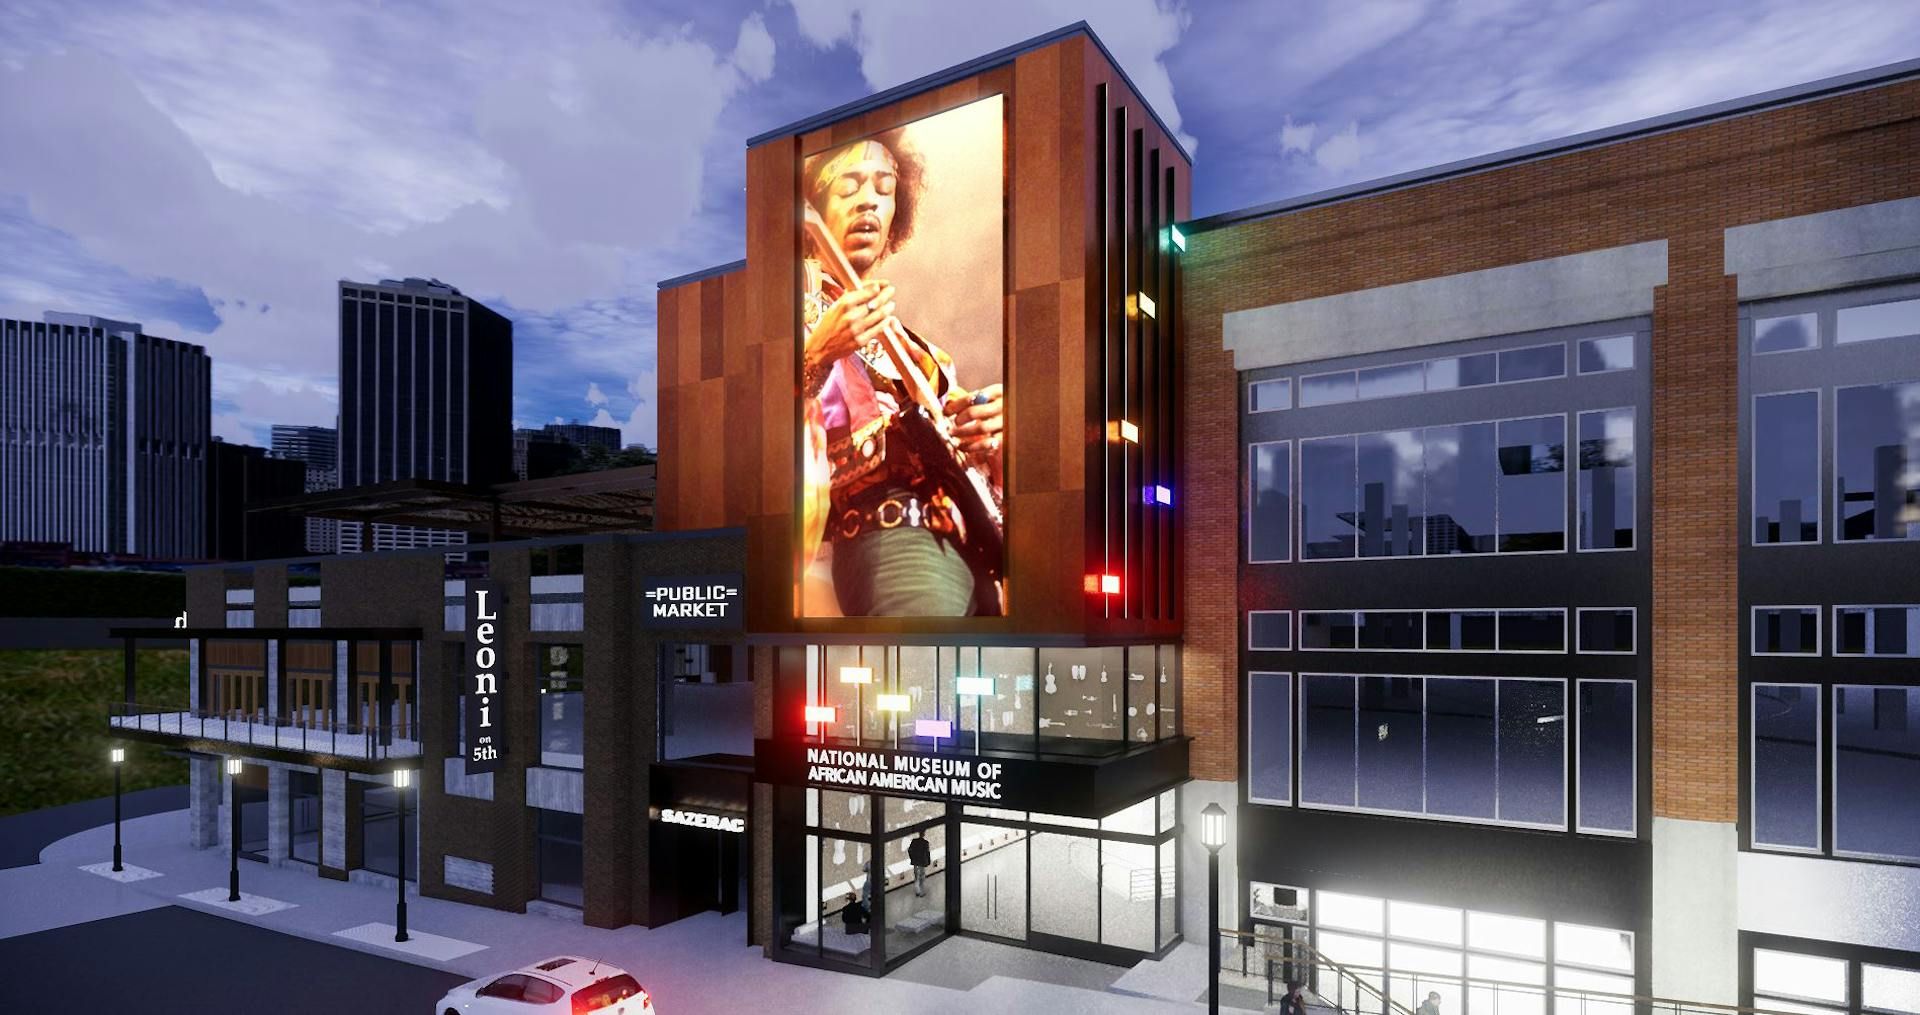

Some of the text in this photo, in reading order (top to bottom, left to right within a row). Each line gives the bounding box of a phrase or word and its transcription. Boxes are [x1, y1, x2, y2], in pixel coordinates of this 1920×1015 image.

[653, 602, 729, 617] MARKET
[475, 590, 497, 728] Leoni
[479, 735, 492, 744] on
[472, 745, 498, 762] 5th
[807, 748, 1002, 780] NATIONAL MUSEUM OF
[807, 765, 1002, 800] AFRICAN AMERICAN MUSIC
[661, 808, 745, 833] SAZERAC
